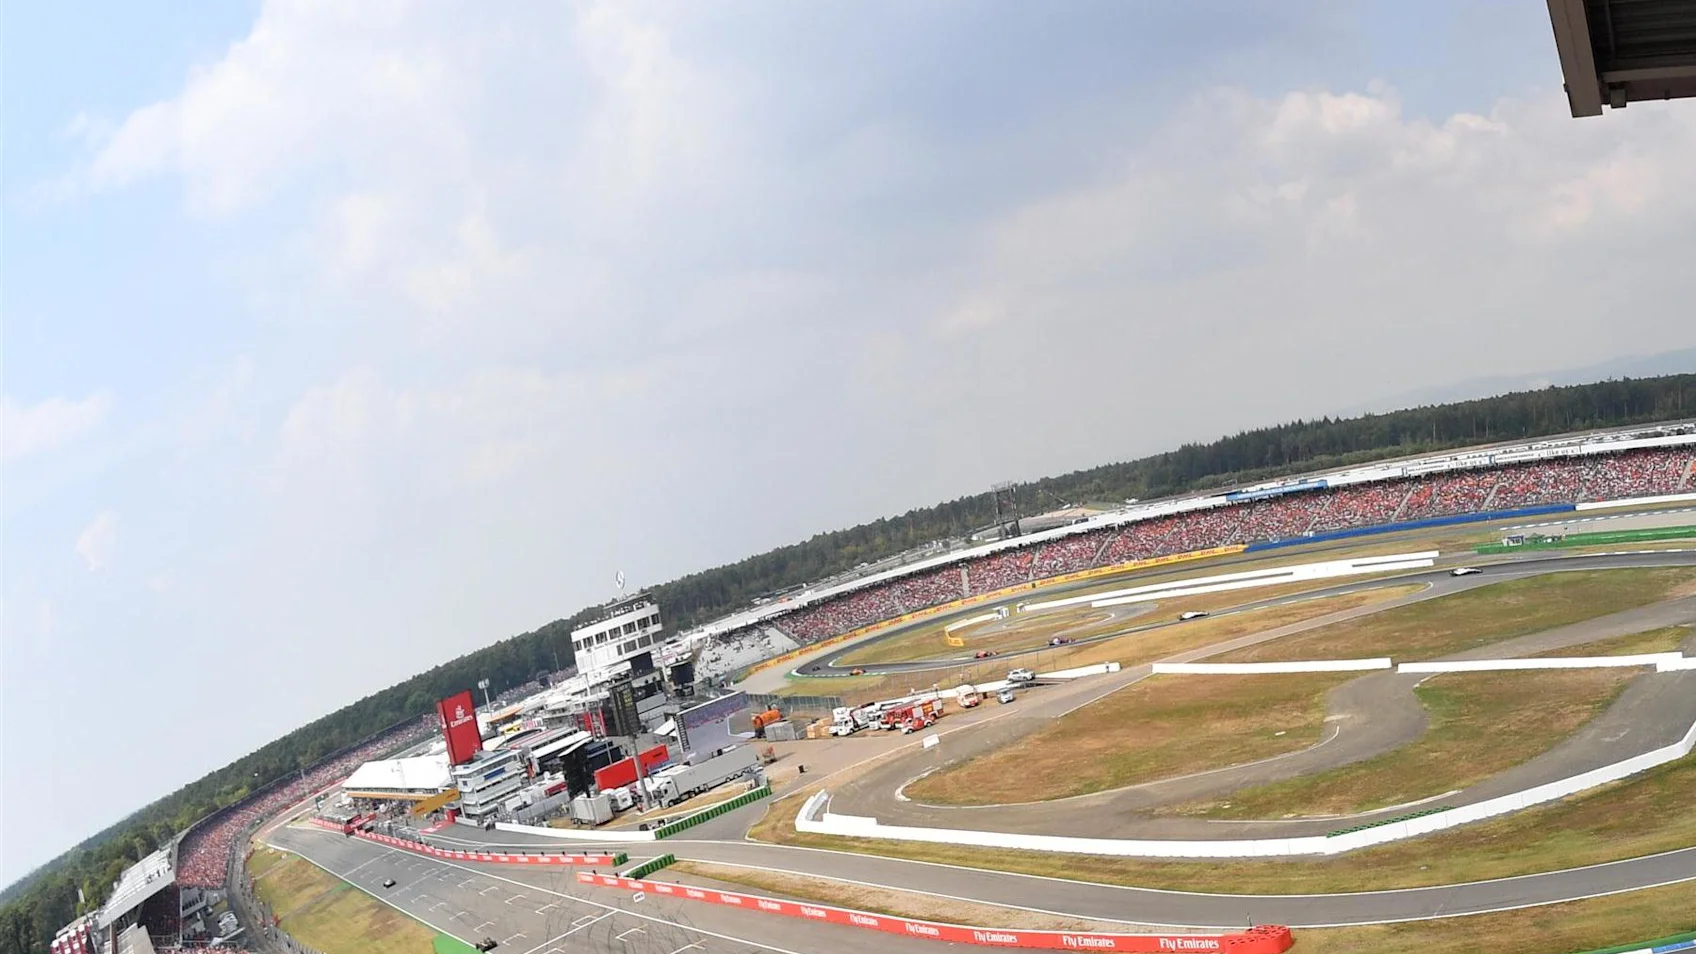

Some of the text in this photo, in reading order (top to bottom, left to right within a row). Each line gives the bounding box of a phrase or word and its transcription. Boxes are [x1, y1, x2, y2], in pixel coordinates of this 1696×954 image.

[973, 931, 1018, 943] Fly Emirates
[1062, 935, 1115, 948] Fly Emirates
[1159, 938, 1219, 950] Fly Emirates
